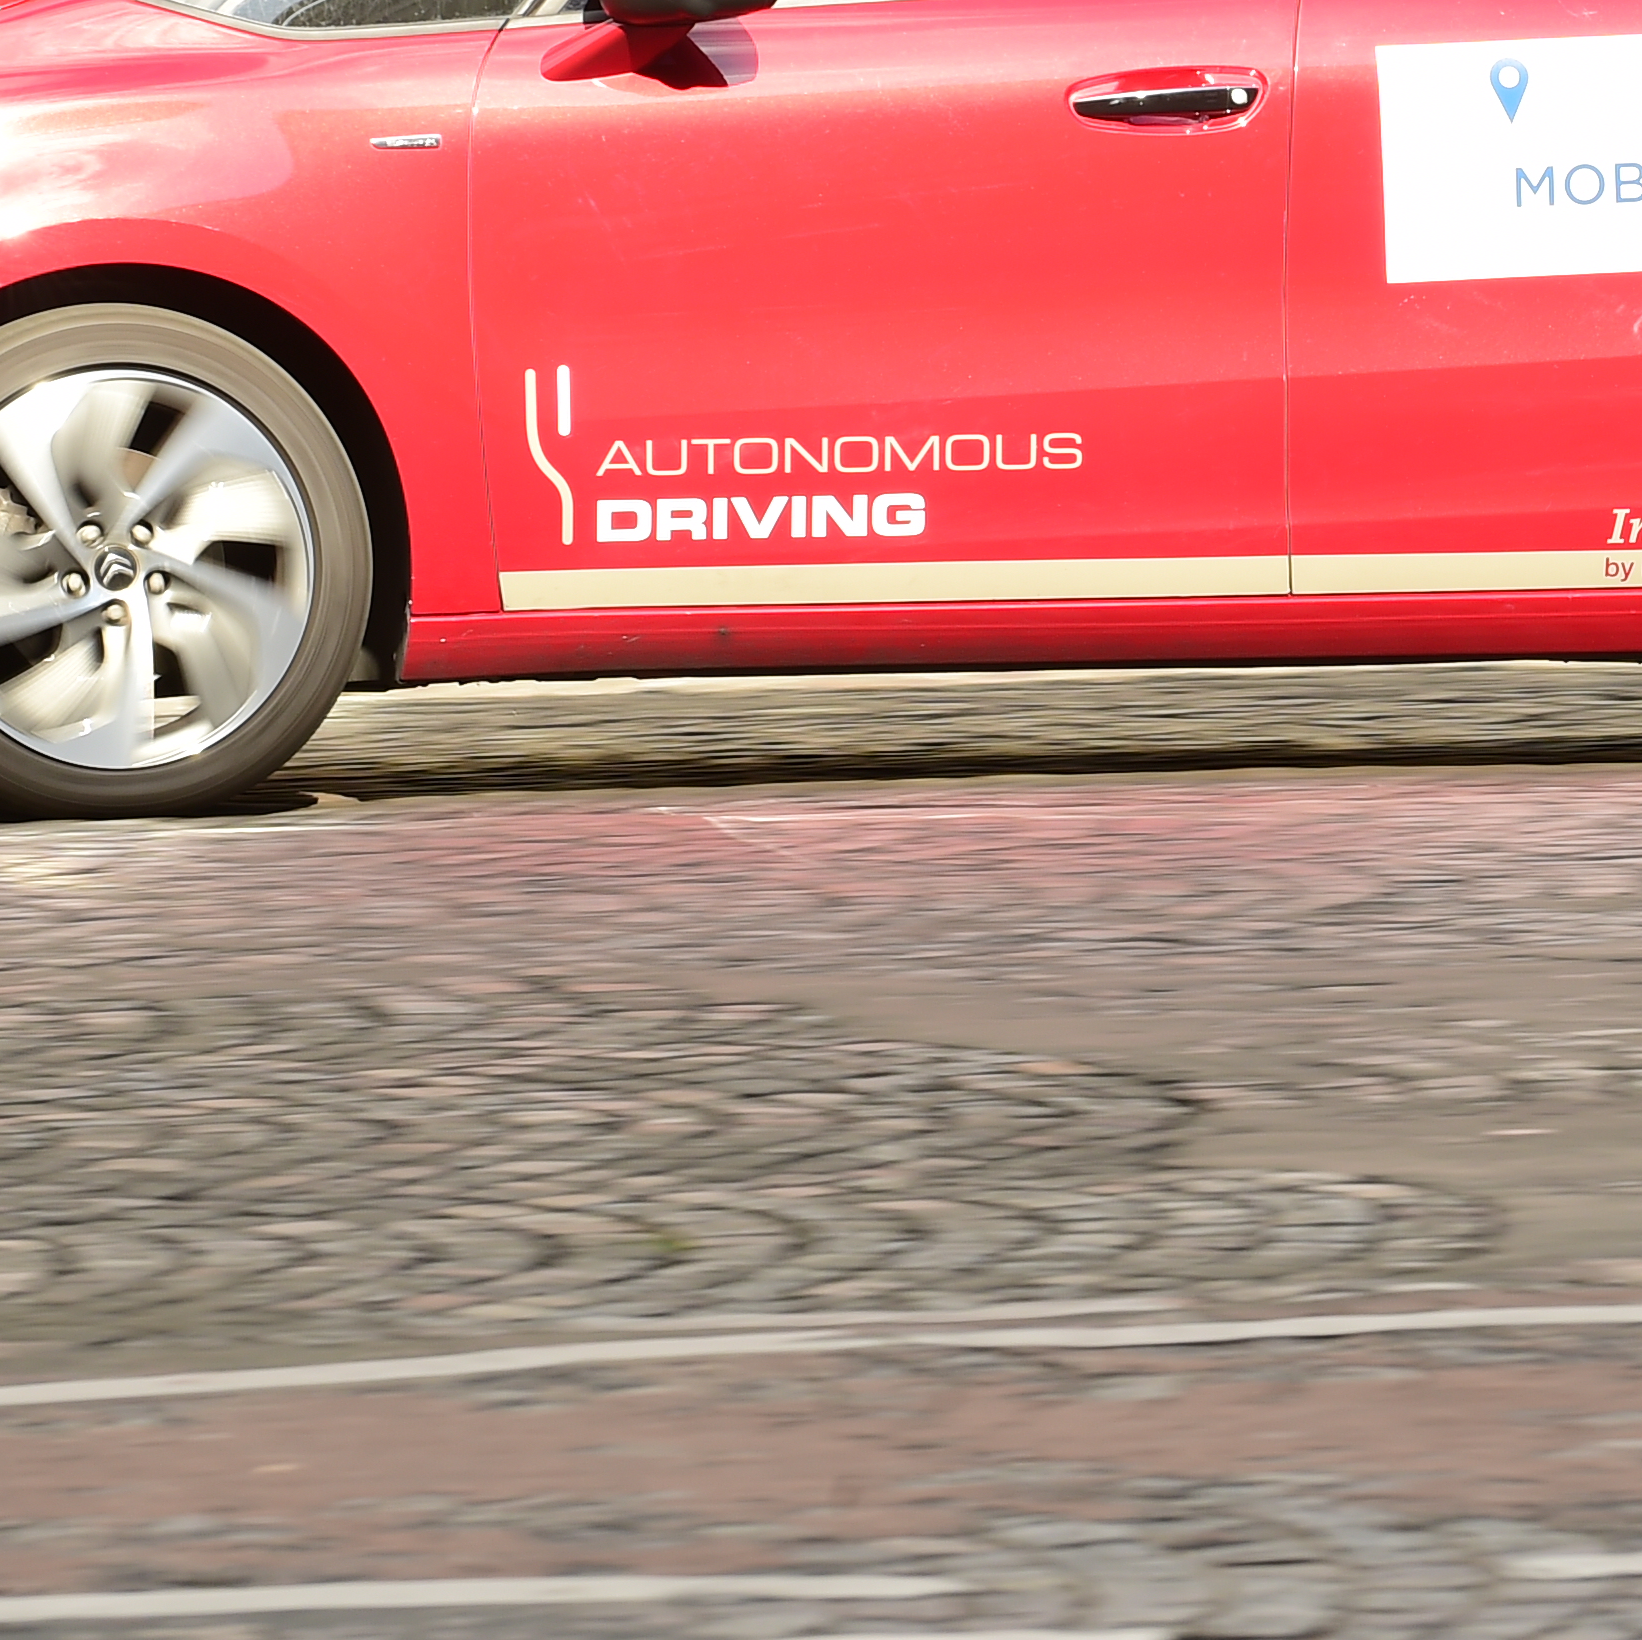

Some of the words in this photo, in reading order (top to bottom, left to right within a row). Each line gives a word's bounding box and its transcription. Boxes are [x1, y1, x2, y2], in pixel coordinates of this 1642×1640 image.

[596, 432, 1084, 477] AUTONOMOUS
[596, 492, 927, 543] DRIVING
[1604, 557, 1634, 582] by
